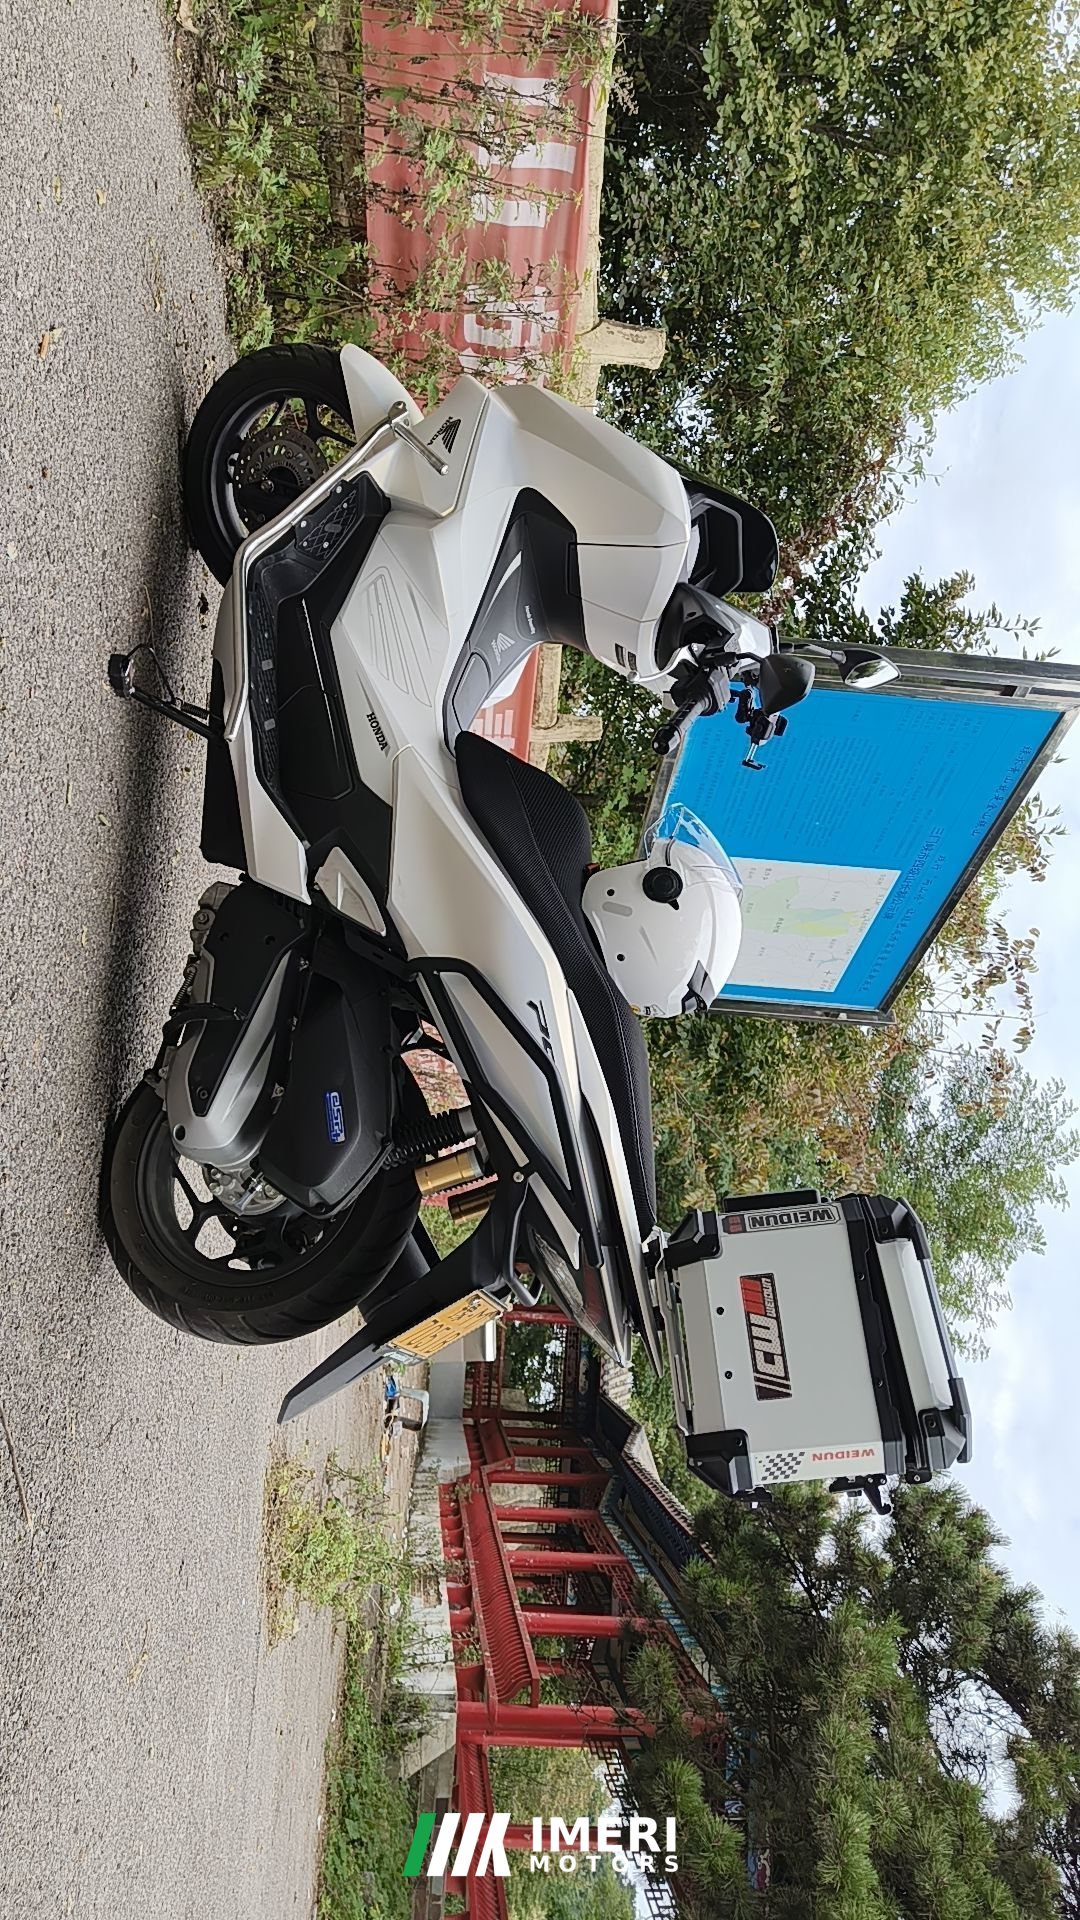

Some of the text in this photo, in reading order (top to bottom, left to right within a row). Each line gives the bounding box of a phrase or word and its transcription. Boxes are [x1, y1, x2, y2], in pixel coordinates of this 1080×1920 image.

[427, 416, 454, 446] HONDA
[366, 711, 389, 751] HONDA
[526, 999, 556, 1064] PC
[749, 1208, 834, 1229] WEIDUN
[811, 1448, 876, 1462] WEIDUN
